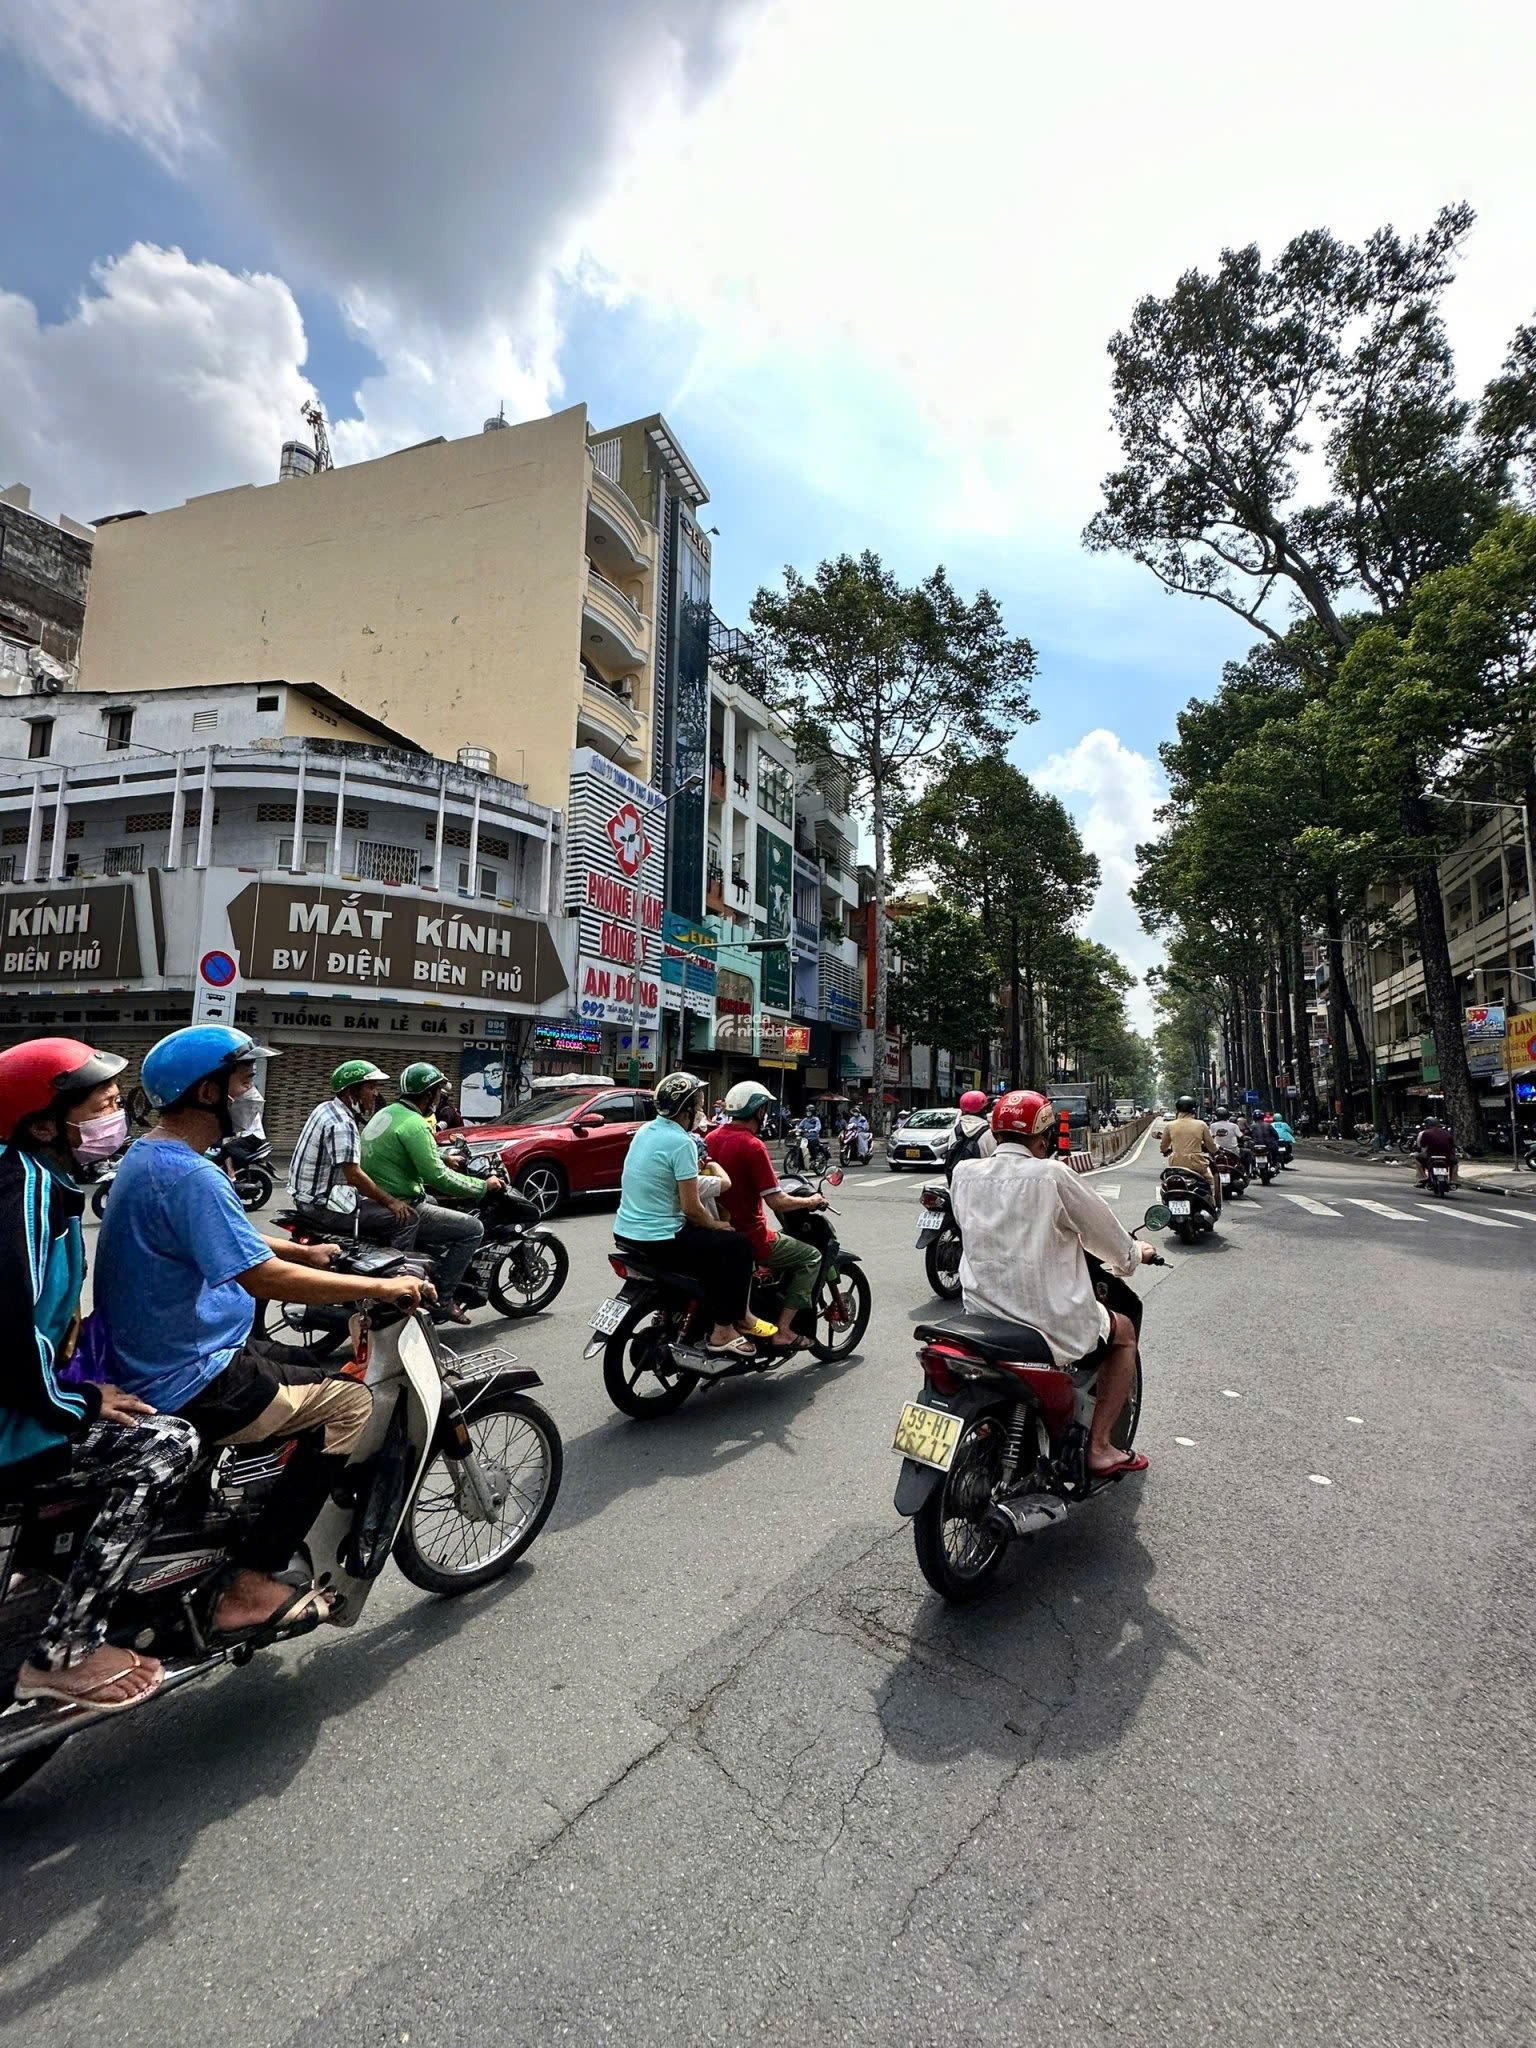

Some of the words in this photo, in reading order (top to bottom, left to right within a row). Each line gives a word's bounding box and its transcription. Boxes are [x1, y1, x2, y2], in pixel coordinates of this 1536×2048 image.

[586, 871, 630, 919] PHÒNG
[8, 897, 90, 937] KÍNH
[288, 893, 393, 940] MẮT
[416, 914, 511, 958] KÍNH
[4, 946, 50, 973] BIÊN
[57, 940, 101, 971] PHỦ
[599, 918, 636, 964] ĐÔNG
[272, 948, 308, 971] BV
[327, 948, 392, 981] ĐIỆN
[413, 958, 467, 986] BIÊN
[481, 966, 523, 993] PHỦ
[583, 967, 611, 999] AN
[235, 1007, 258, 1025] HỆ
[271, 1005, 332, 1027] THỐNG
[344, 1011, 380, 1030] BÁN
[390, 1014, 410, 1032] LẺ
[421, 1016, 448, 1035] GIÁ
[582, 1000, 606, 1018] 992
[487, 1020, 506, 1030] 994
[463, 1041, 518, 1052] POLICE
[621, 1036, 650, 1049] 92
[343, 1068, 366, 1079] Grab
[421, 1071, 438, 1083] Grab
